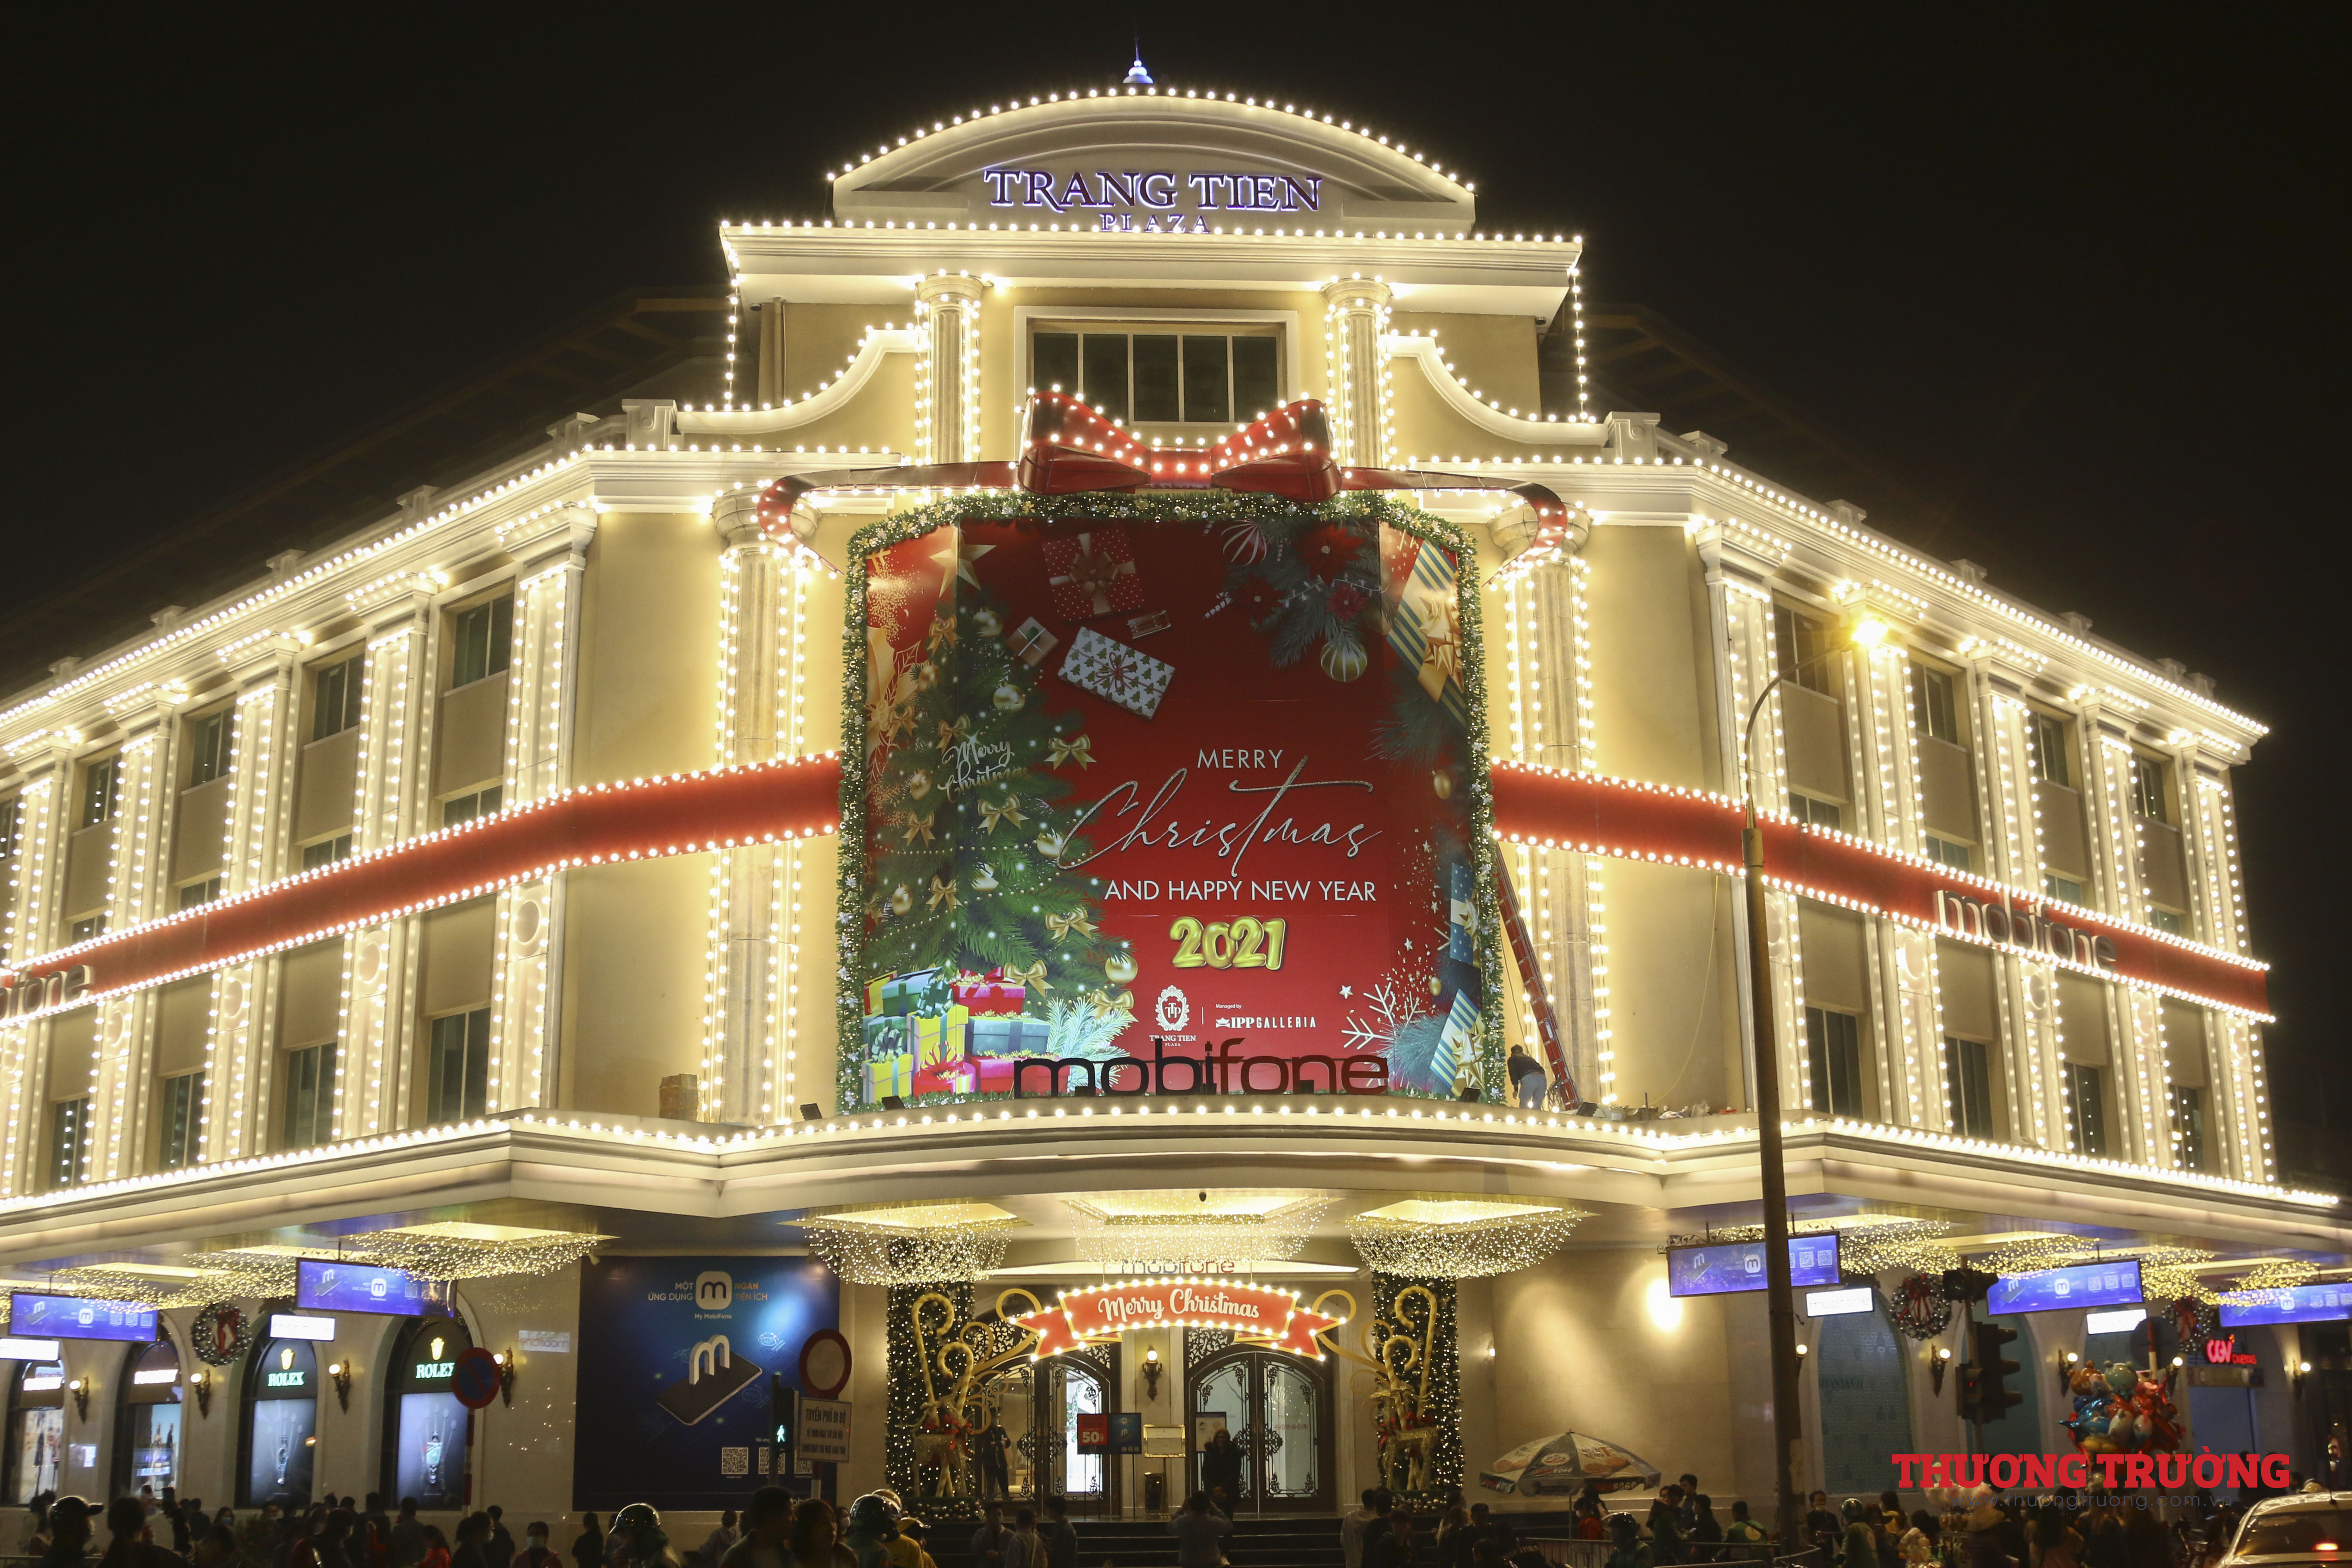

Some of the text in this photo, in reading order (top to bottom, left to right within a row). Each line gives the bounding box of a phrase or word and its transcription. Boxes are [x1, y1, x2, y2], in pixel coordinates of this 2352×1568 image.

[983, 170, 1323, 212] TRANG TIEN
[1100, 214, 1211, 234] PLAZA
[942, 740, 1015, 769] Merry
[1197, 748, 1283, 769] MERRY
[1056, 755, 1383, 878] Christmas
[1104, 880, 1377, 902] AND HAPPY NEW YEAR
[1937, 887, 2117, 973] mobifone
[1169, 916, 1287, 971] 2021
[1014, 1037, 1389, 1096] mobifone
[648, 1291, 667, 1301] ỨNG
[669, 1292, 694, 1302] DỤNG
[675, 1280, 694, 1292] MỘT
[1098, 1288, 1260, 1322] Merry Christmas
[2207, 1339, 2233, 1363] CGV
[267, 1371, 305, 1387] ROLEX
[415, 1362, 456, 1379] ROLEX
[1082, 1431, 1100, 1443] 50
